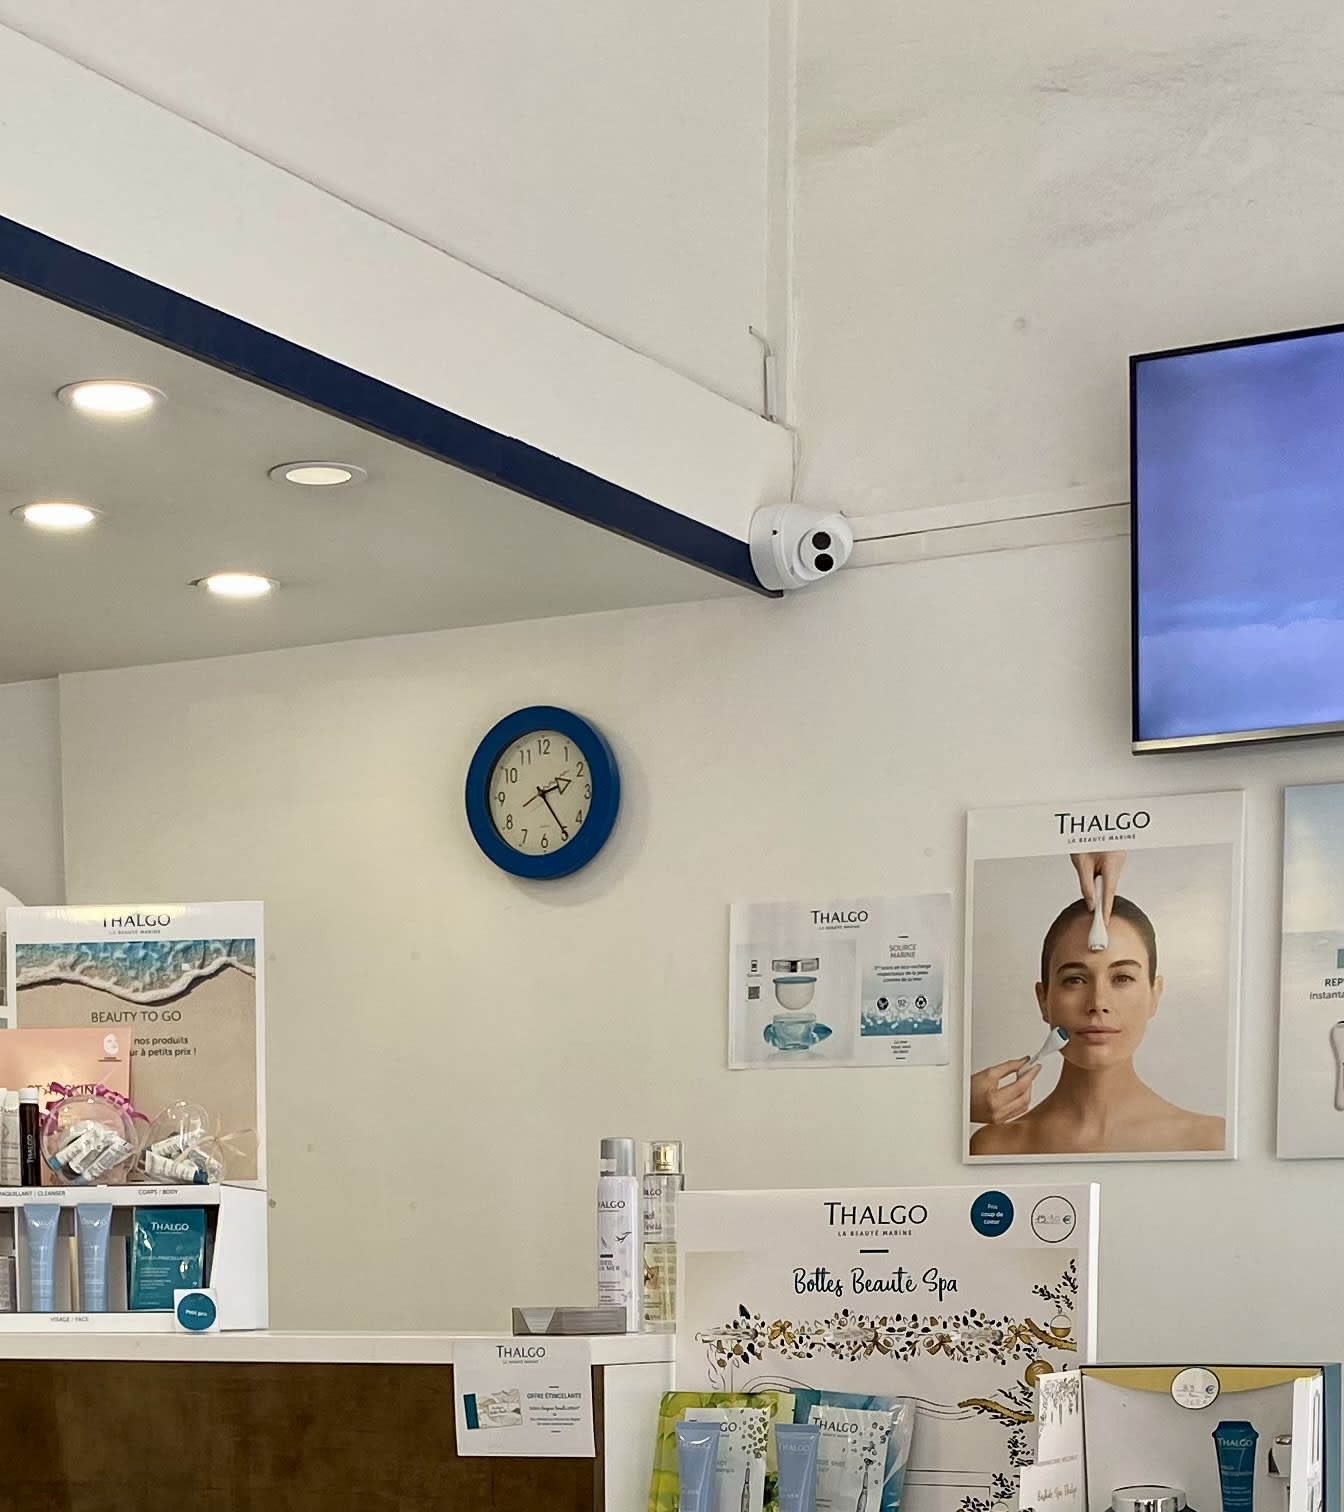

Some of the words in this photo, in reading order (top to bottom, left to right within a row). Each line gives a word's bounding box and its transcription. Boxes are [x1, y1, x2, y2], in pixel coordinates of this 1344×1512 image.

[537, 739, 551, 755] 12
[564, 746, 570, 762] 1
[519, 749, 532, 765] 11
[505, 767, 518, 784] 10
[576, 761, 584, 777] 2
[497, 791, 506, 807] 9
[584, 784, 592, 800] 3
[506, 814, 513, 830] 8
[575, 809, 583, 825] 4
[1054, 811, 1151, 835] THALGO
[521, 829, 528, 845] 7
[541, 833, 549, 849] 6
[810, 910, 869, 925] THALGO
[91, 1011, 137, 1023] BEAUTY
[142, 1011, 159, 1022] TO
[162, 1010, 182, 1022] GO
[134, 1038, 150, 1046] nos
[152, 1035, 188, 1047] produits
[148, 1047, 173, 1058] petits
[175, 1047, 191, 1058] prix
[823, 1201, 928, 1225] THALGO
[151, 1221, 190, 1232] THALGO
[850, 1266, 918, 1294] Beauté
[922, 1266, 959, 1302] Spa
[496, 1345, 546, 1360] THALGO
[812, 1416, 859, 1434] THALGO
[1217, 1437, 1254, 1447] THALGO
